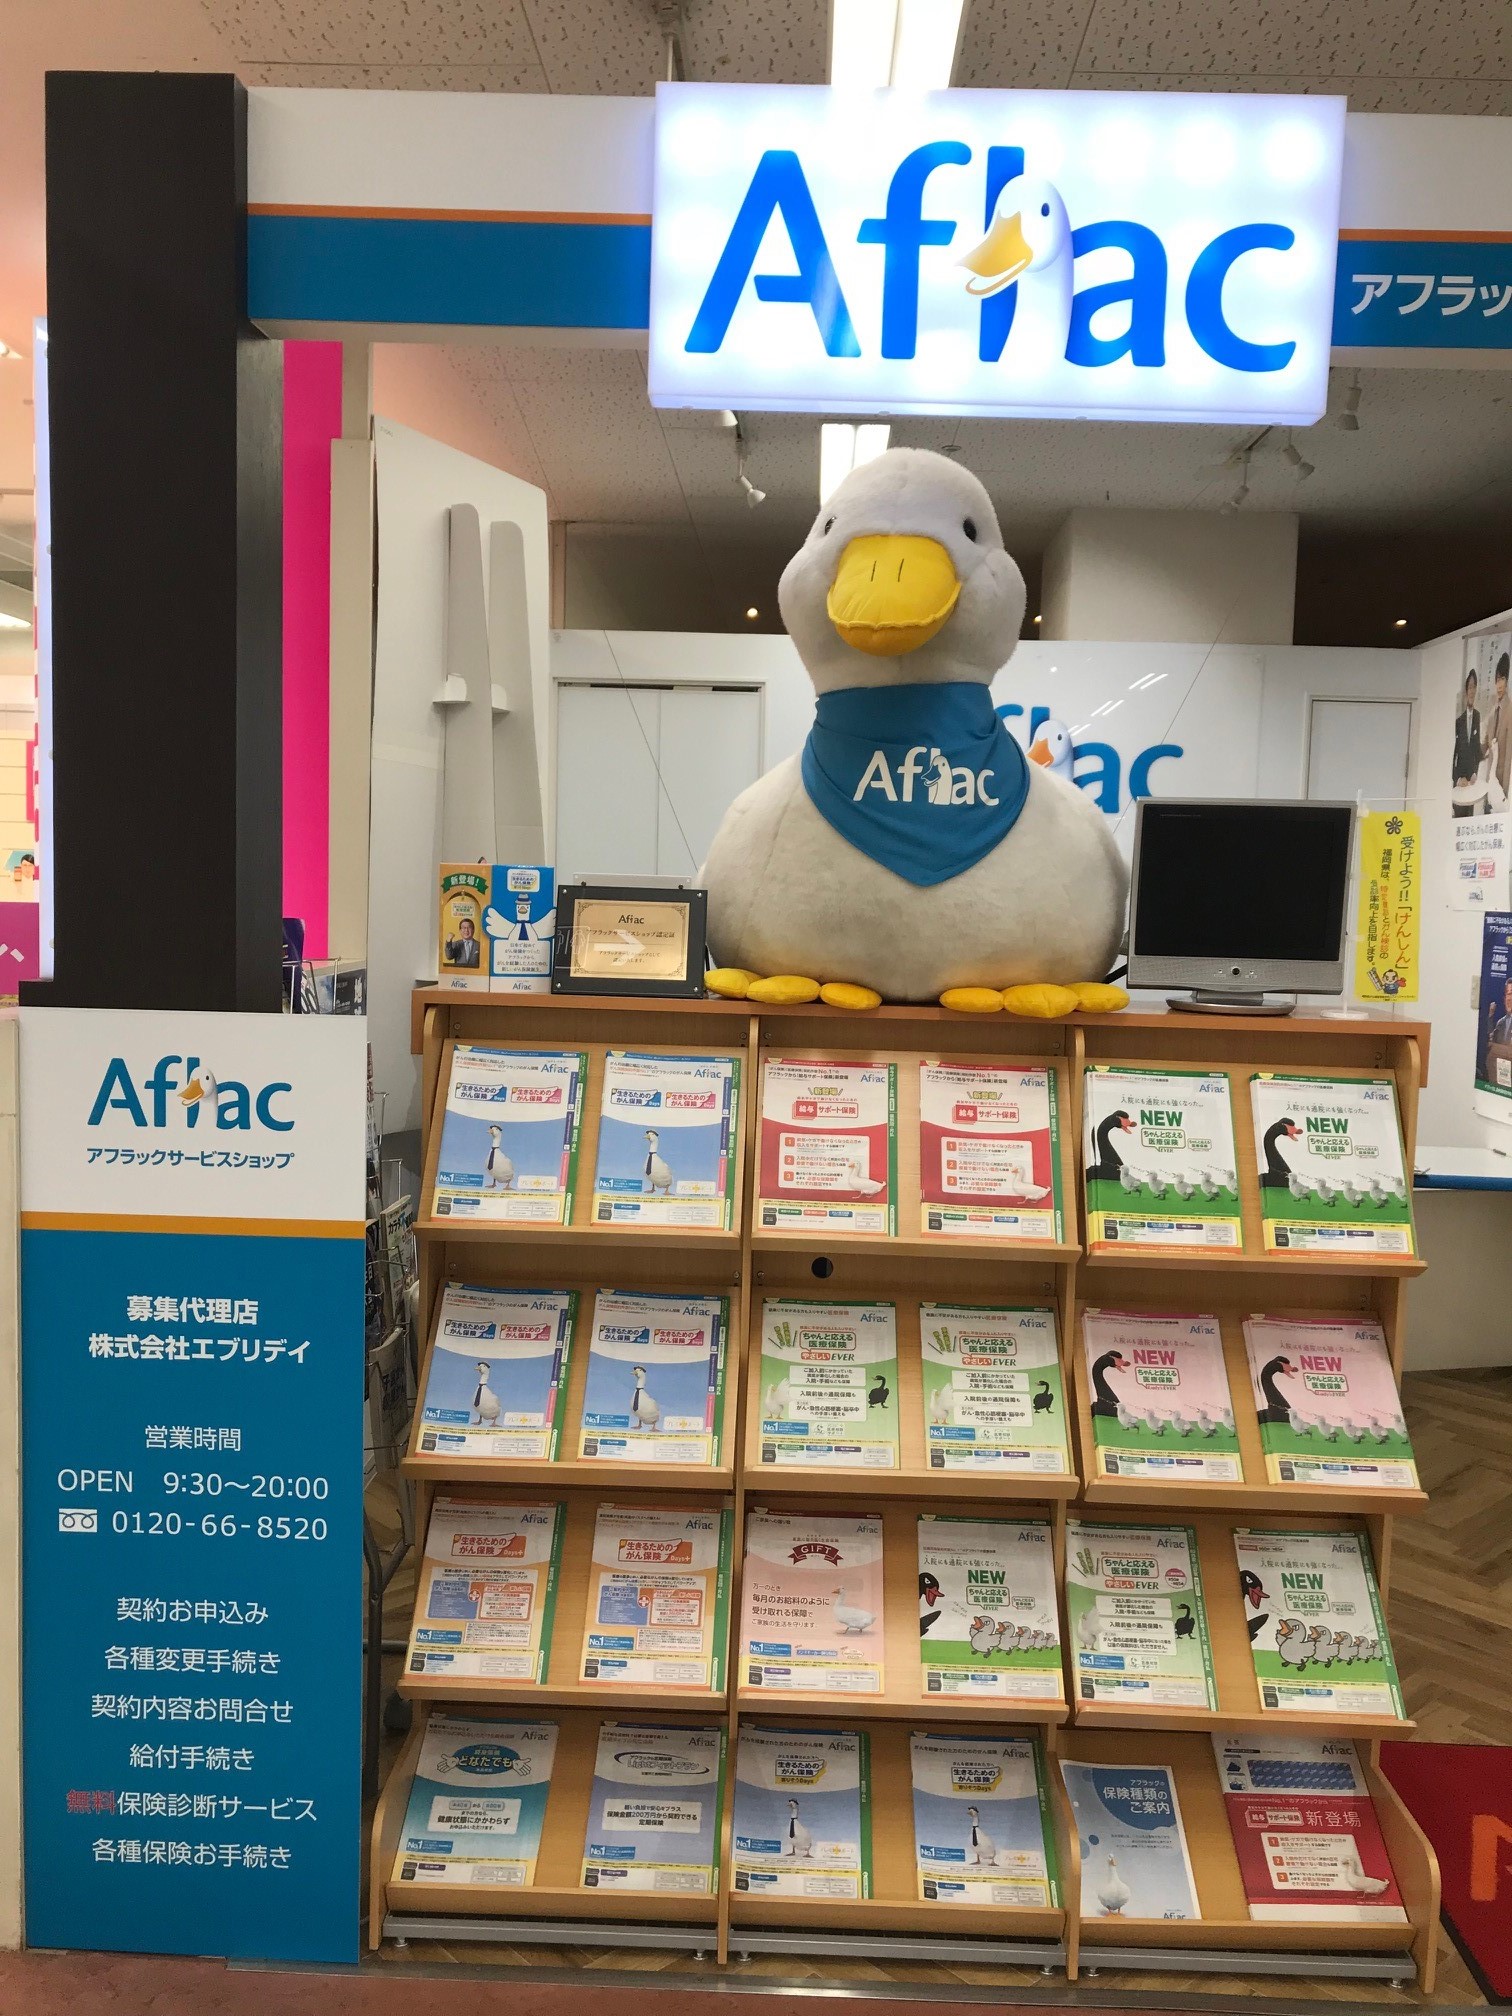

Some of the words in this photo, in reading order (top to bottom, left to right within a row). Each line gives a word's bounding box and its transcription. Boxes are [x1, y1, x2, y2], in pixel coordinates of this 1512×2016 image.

[684, 140, 1296, 372] Aflac
[1351, 275, 1512, 317] アフラッ
[853, 746, 999, 805] Aflac
[618, 915, 644, 924] Aflac
[541, 1064, 568, 1073] Aflac
[694, 1069, 721, 1078] Aflac
[861, 1074, 885, 1083] Aflac
[1020, 1078, 1045, 1086] Aflac
[462, 1085, 496, 1093] 生きるための
[1200, 1084, 1224, 1093] Aflac
[87, 1055, 295, 1132] Aflac
[617, 1090, 651, 1098] 生きるための
[1364, 1092, 1389, 1100] Aflac
[1141, 1110, 1182, 1126] NEW
[1306, 1117, 1348, 1134] NEW
[87, 1148, 294, 1169] アフラックサービスショップ
[440, 1174, 454, 1182] No.1
[600, 1179, 613, 1187] No.1
[127, 1296, 259, 1325] 募集代理店
[531, 1302, 558, 1311] Aflac
[683, 1307, 710, 1316] Aflac
[860, 1314, 887, 1322] Aflac
[451, 1322, 485, 1330] 生きるための
[1020, 1319, 1046, 1328] Aflac
[1190, 1326, 1214, 1334] Aflac
[1355, 1332, 1379, 1340] Aflac
[89, 1334, 311, 1363] 株式会社エブリデイ
[1133, 1350, 1175, 1365] NEW
[1300, 1355, 1341, 1371] NEW
[426, 1410, 440, 1418] No.1
[586, 1415, 600, 1423] No.1
[764, 1423, 778, 1432] No.1
[145, 1425, 241, 1451] 営業時間
[57, 1469, 133, 1493] OPEN
[521, 1514, 548, 1524] Aflac
[112, 1511, 327, 1540] 0120-66-8520
[686, 1520, 712, 1529] Aflac
[461, 1536, 506, 1545] 生きるための
[1018, 1532, 1045, 1542] Aflac
[627, 1542, 672, 1551] 生きるための
[1157, 1539, 1185, 1548] Aflac
[459, 1546, 495, 1554] がん保険
[1332, 1545, 1356, 1553] Aflac
[626, 1552, 661, 1560] がん保険
[1105, 1560, 1155, 1568] ちゃんと応える
[1112, 1568, 1149, 1576] 医療保険
[968, 1570, 1005, 1584] NEW
[1281, 1573, 1323, 1589] NEW
[753, 1583, 781, 1591] 万一のとき
[753, 1594, 829, 1605] 毎月のお給料のように
[117, 1597, 268, 1625] 契約お申込み
[752, 1606, 813, 1617] 受け取れる保障で
[418, 1631, 432, 1640] No.1
[590, 1638, 604, 1646] No.1
[751, 1644, 763, 1652] No.1
[105, 1646, 281, 1675] 各種変更手続き
[1081, 1656, 1094, 1665] No.1
[91, 1695, 293, 1724] 契約内容お問合せ
[522, 1732, 548, 1740] Aflac
[689, 1738, 715, 1746] Aflac
[829, 1742, 855, 1751] Aflac
[1003, 1749, 1029, 1758] Aflac
[1322, 1745, 1352, 1755] Aflac
[130, 1744, 254, 1771] 給付手続き
[458, 1757, 512, 1766] どなたでも
[1103, 1787, 1167, 1800] 保険種類の
[66, 1789, 317, 1821] 無料保険診断サービス
[1131, 1801, 1170, 1814] ご案内
[438, 1816, 510, 1825] 健康状態にかかわらず
[607, 1812, 697, 1820] 保険金額200万円から契約できる
[1306, 1811, 1361, 1827] 新登場
[408, 1841, 422, 1849] No.1
[737, 1839, 750, 1848] No.1
[93, 1838, 292, 1869] 各種保険お手続き
[591, 1847, 605, 1855] No.1
[921, 1848, 934, 1856] No.1
